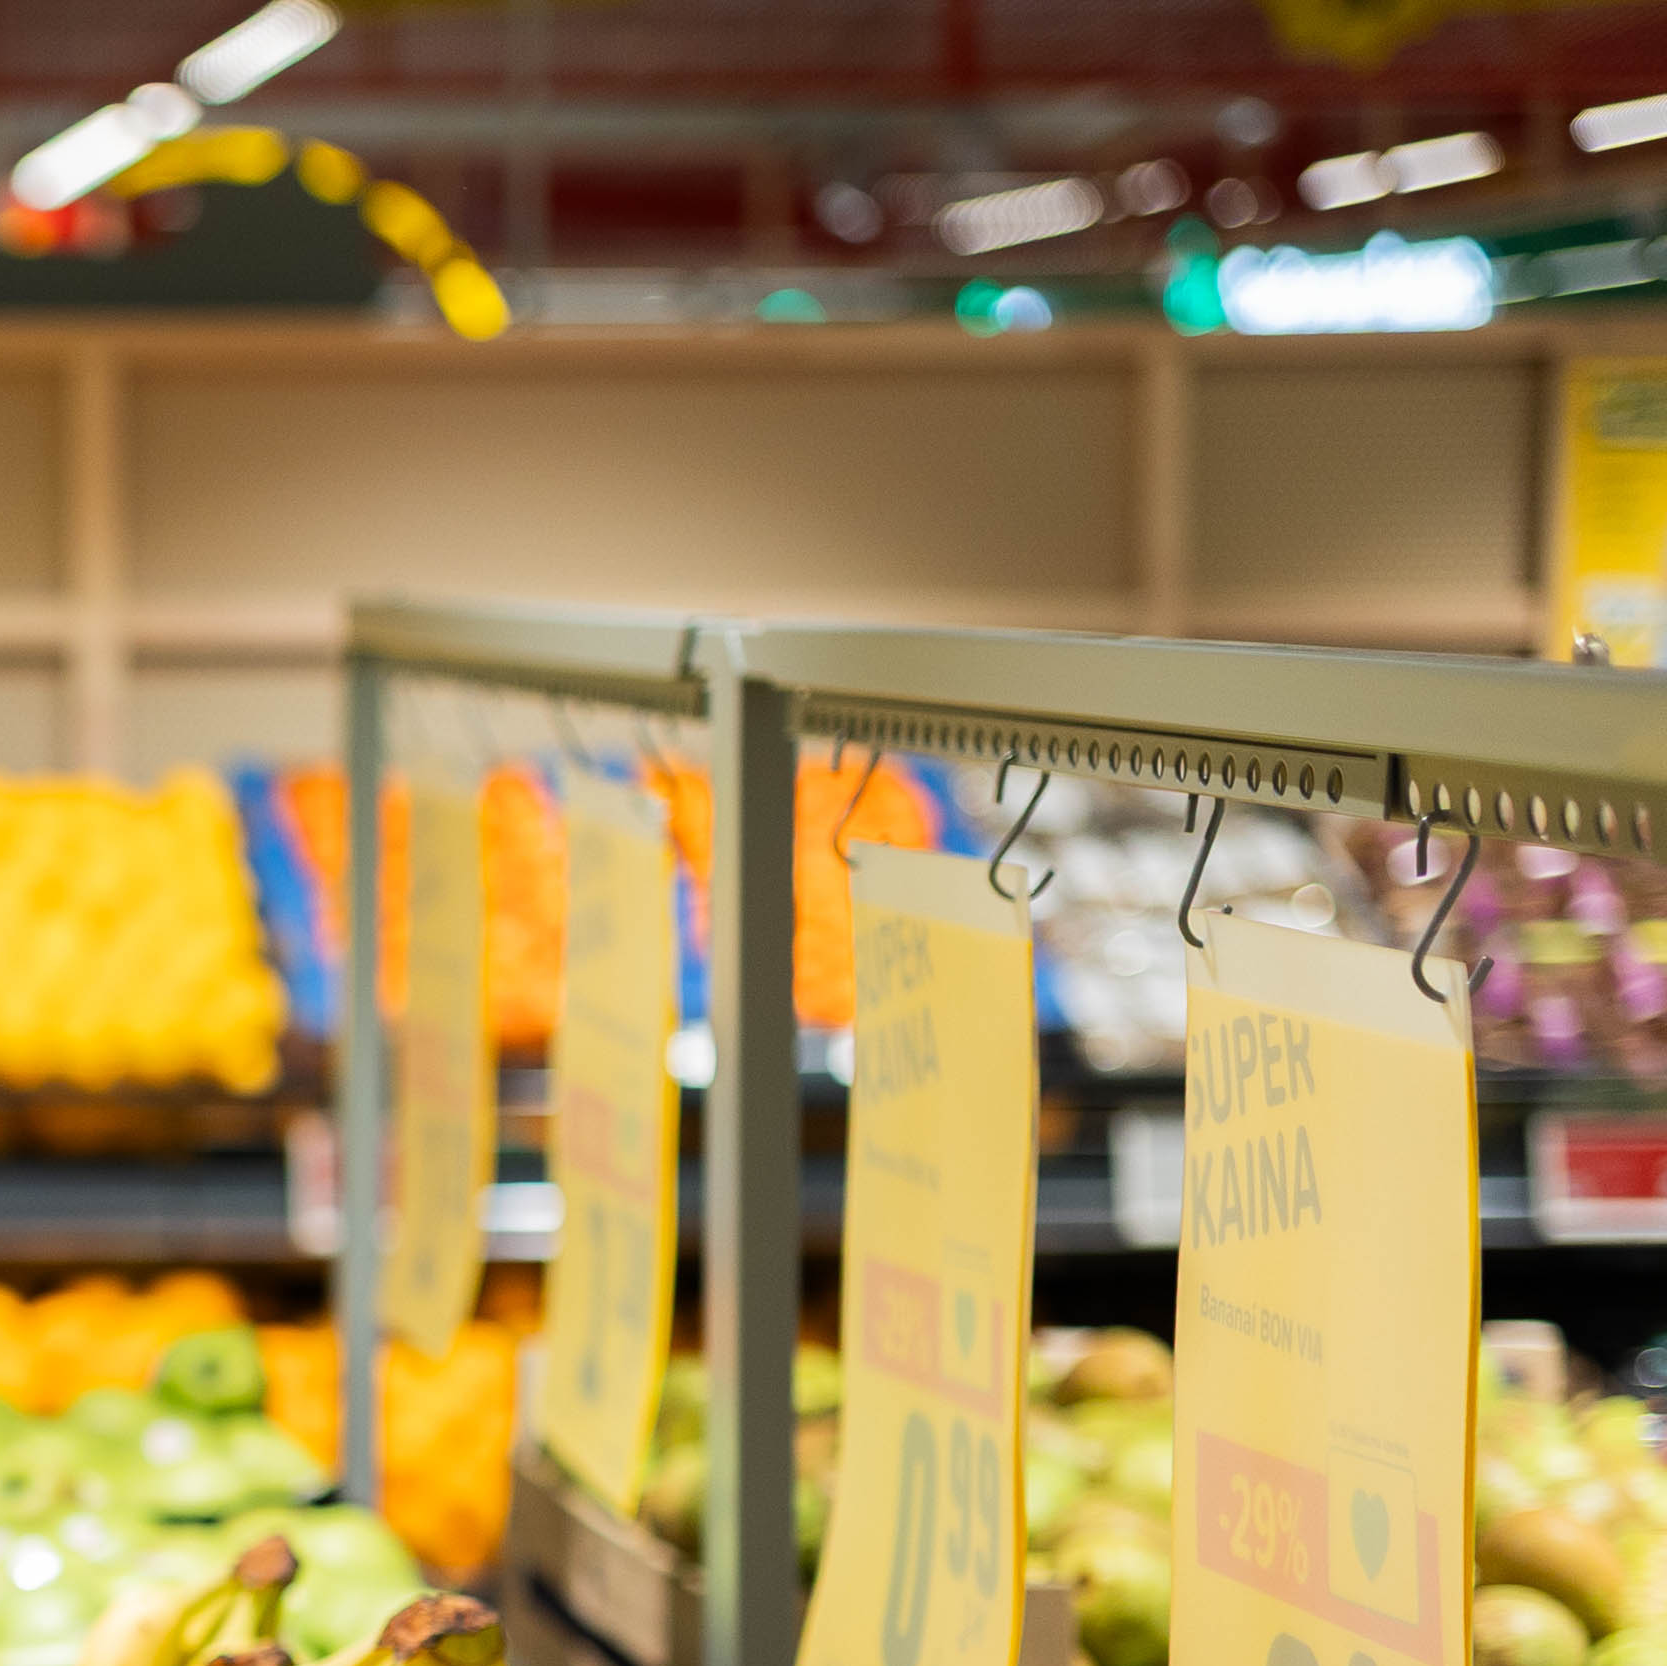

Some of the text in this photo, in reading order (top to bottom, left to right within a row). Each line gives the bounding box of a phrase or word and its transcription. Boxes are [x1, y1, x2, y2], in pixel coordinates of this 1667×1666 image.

[1190, 1124, 1322, 1250] KAINA
[1200, 1283, 1323, 1368] Bananai BON VIA
